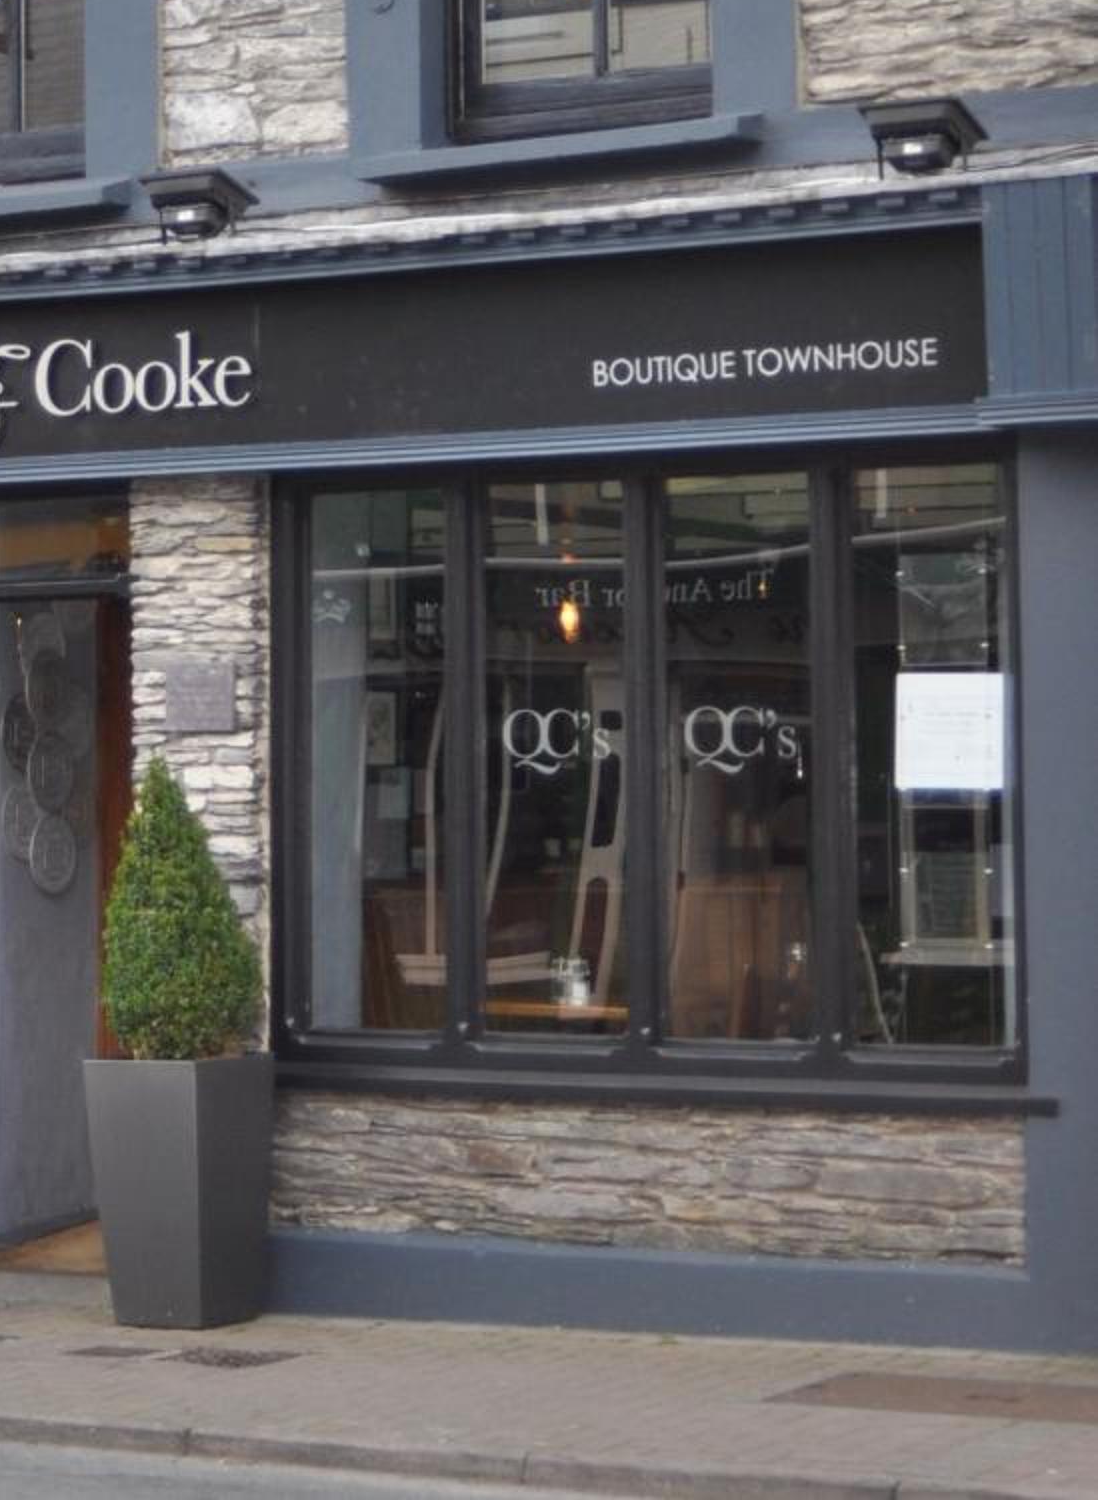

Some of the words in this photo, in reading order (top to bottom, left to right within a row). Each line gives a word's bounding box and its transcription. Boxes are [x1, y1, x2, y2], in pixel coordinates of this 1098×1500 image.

[34, 331, 253, 417] Cooke
[593, 350, 736, 388] BOUTIQUE
[742, 337, 938, 377] TOWNHOUSE
[503, 708, 612, 775] QC's
[684, 705, 798, 774] QC's
